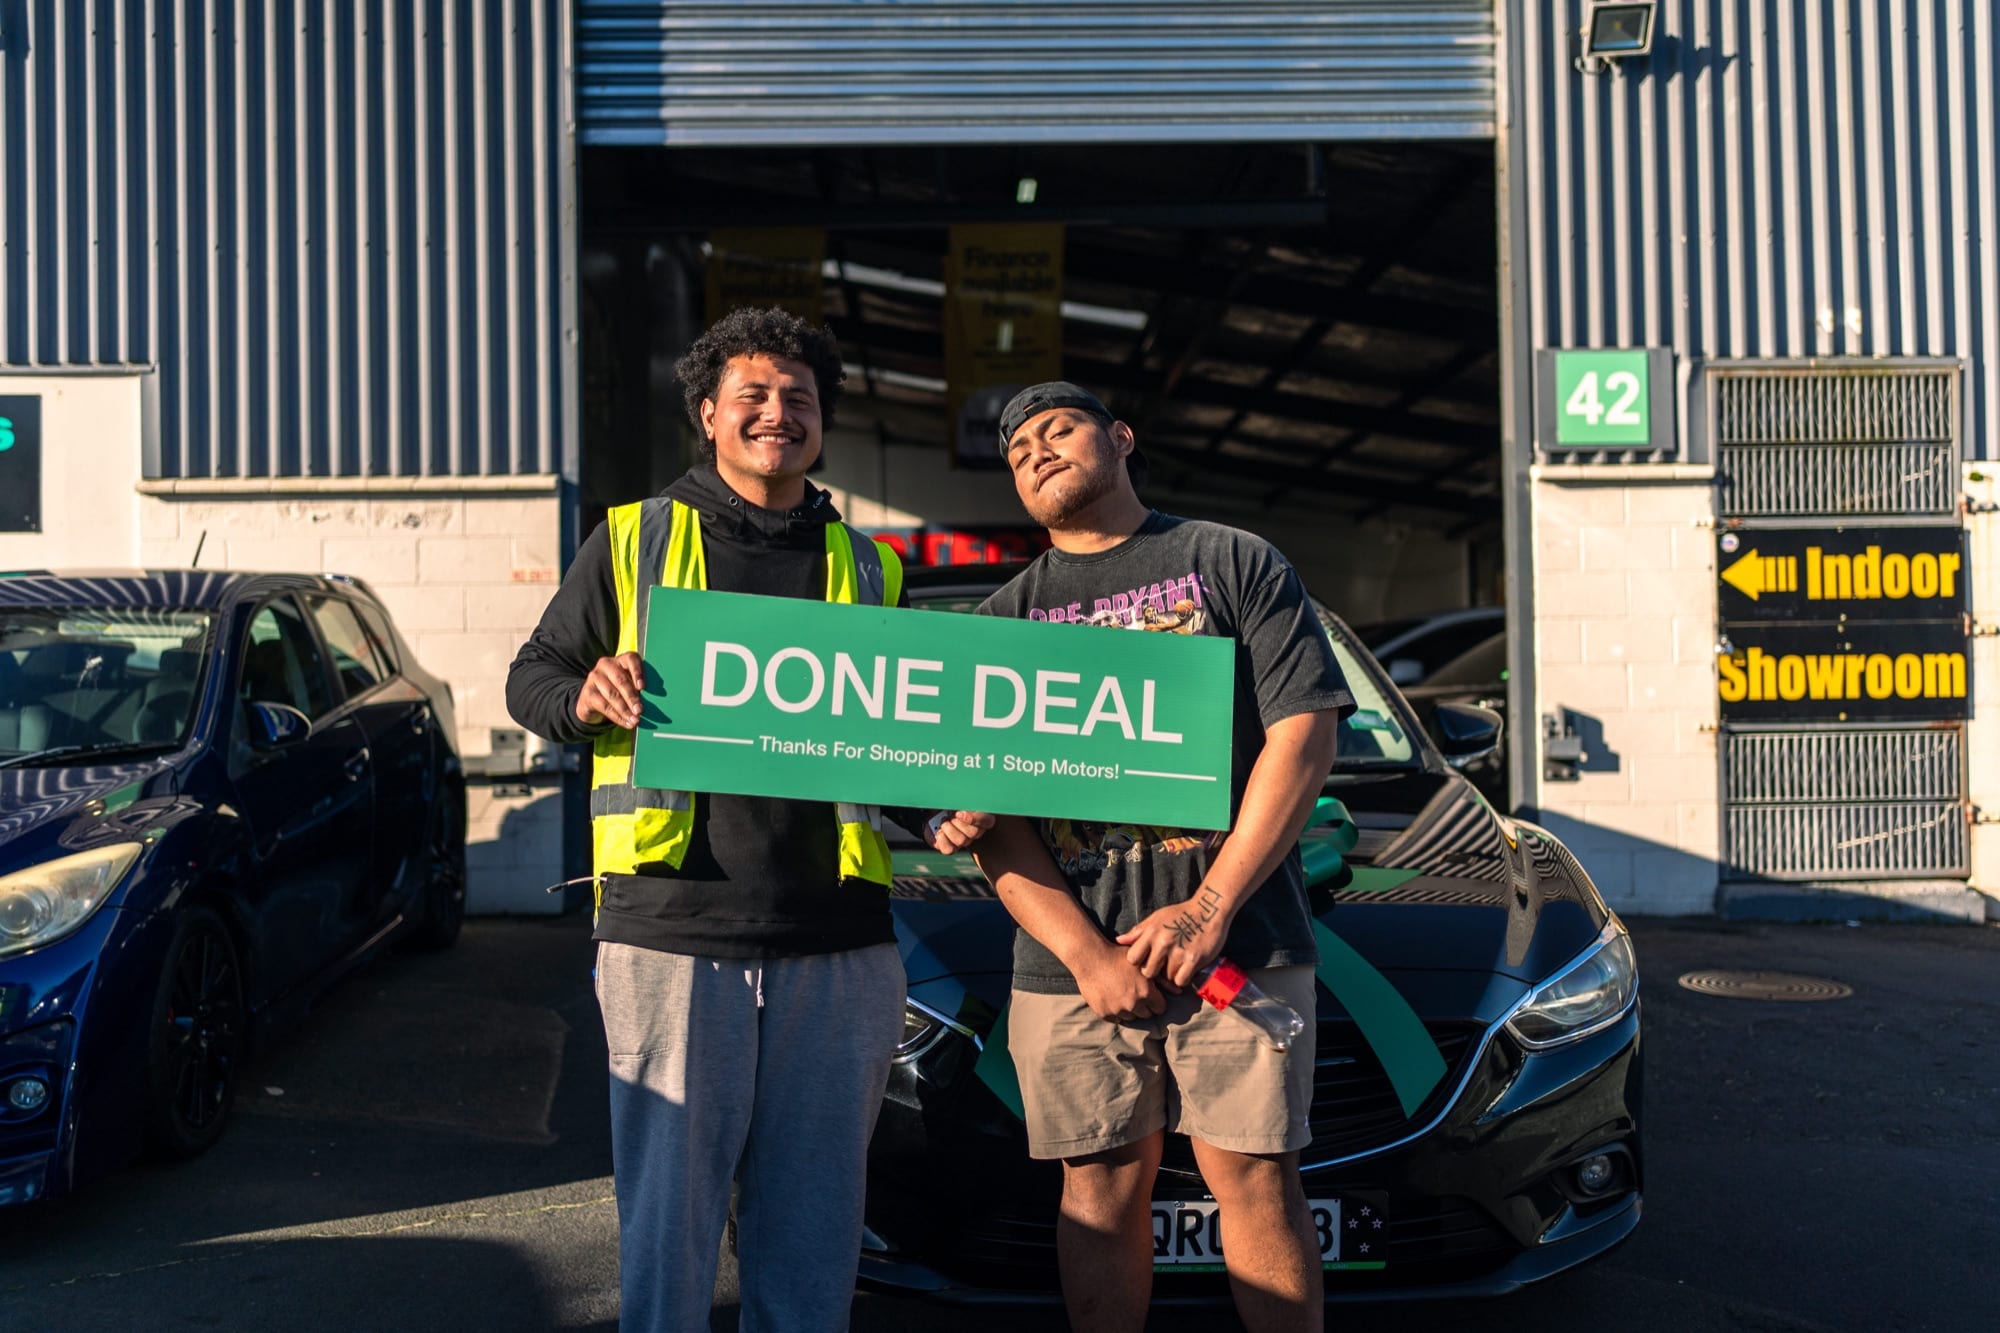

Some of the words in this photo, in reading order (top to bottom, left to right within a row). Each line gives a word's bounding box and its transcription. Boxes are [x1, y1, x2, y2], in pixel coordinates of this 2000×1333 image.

[1566, 371, 1640, 425] 42
[1806, 546, 1960, 600] Indoor
[700, 641, 944, 724] DONE
[972, 664, 1183, 744] DEAL
[759, 735, 828, 757] Thanks
[833, 741, 865, 759] For
[870, 744, 958, 770] Shopping
[963, 754, 981, 769] at
[987, 755, 995, 770] 1
[1003, 754, 1046, 777] Stop
[1051, 759, 1120, 780] Motors!
